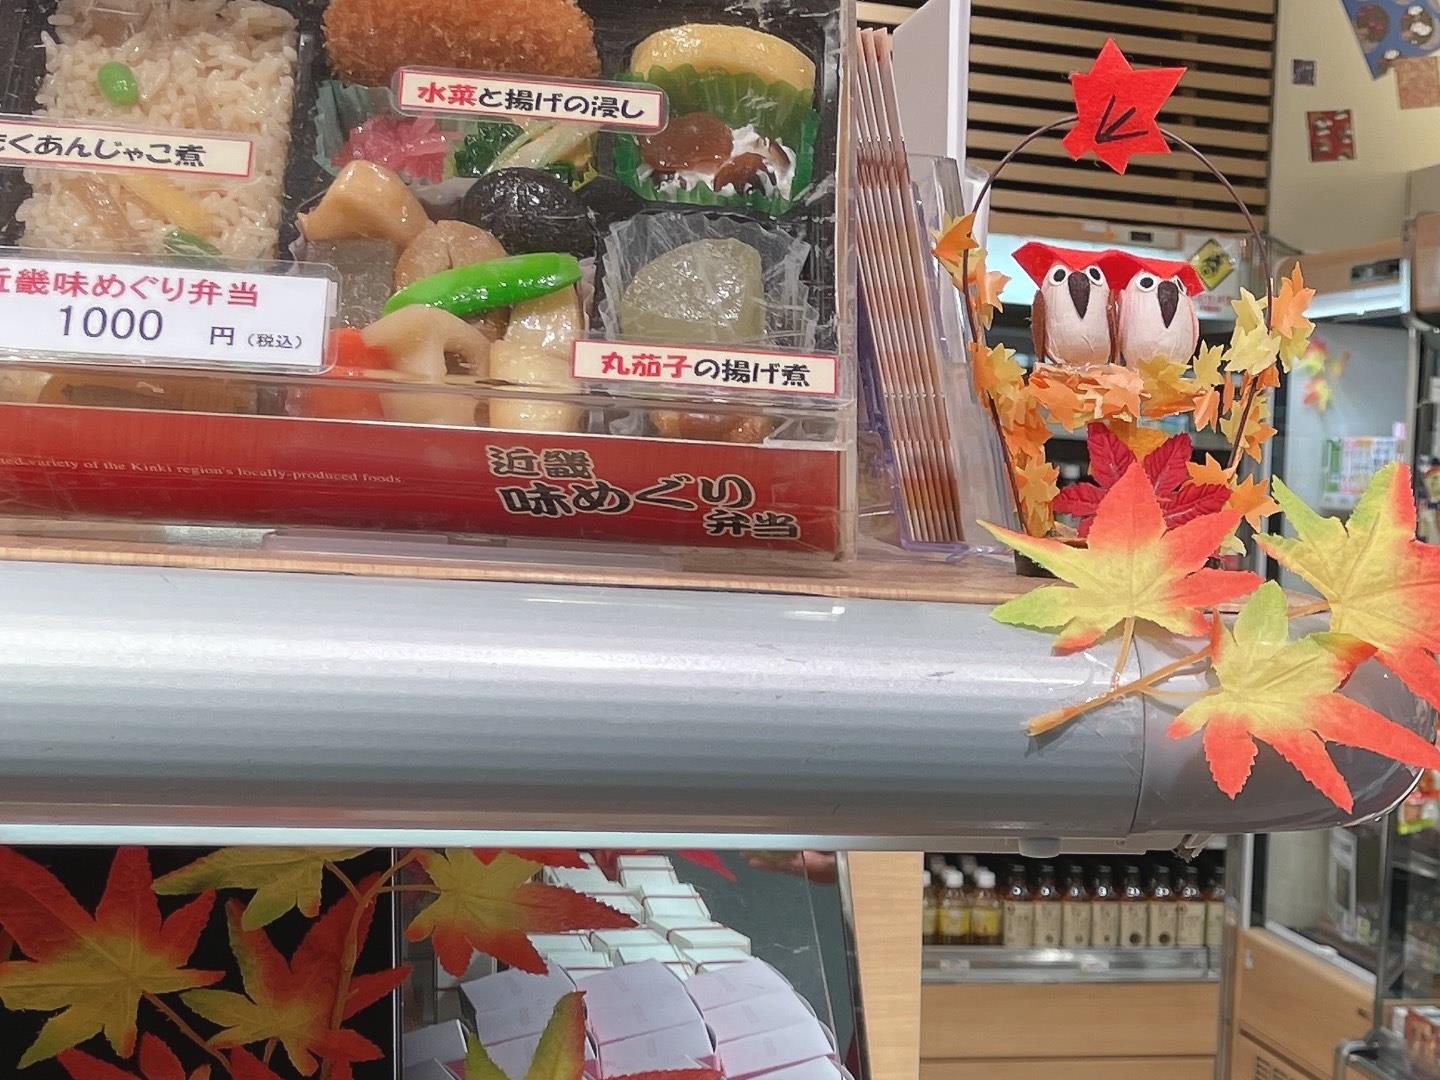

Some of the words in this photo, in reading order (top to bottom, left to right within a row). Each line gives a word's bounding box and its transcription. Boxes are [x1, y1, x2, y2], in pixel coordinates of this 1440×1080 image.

[417, 81, 645, 120] 水菜と揚げの浸し
[0, 132, 207, 168] くあんじゃこ煮
[60, 305, 164, 341] 1000
[209, 326, 235, 346] 円
[601, 351, 810, 387] 丸茄子の揚げ煮
[485, 447, 596, 481] 近畿
[497, 473, 756, 518] 味めぐり
[702, 508, 800, 538] 弁当
